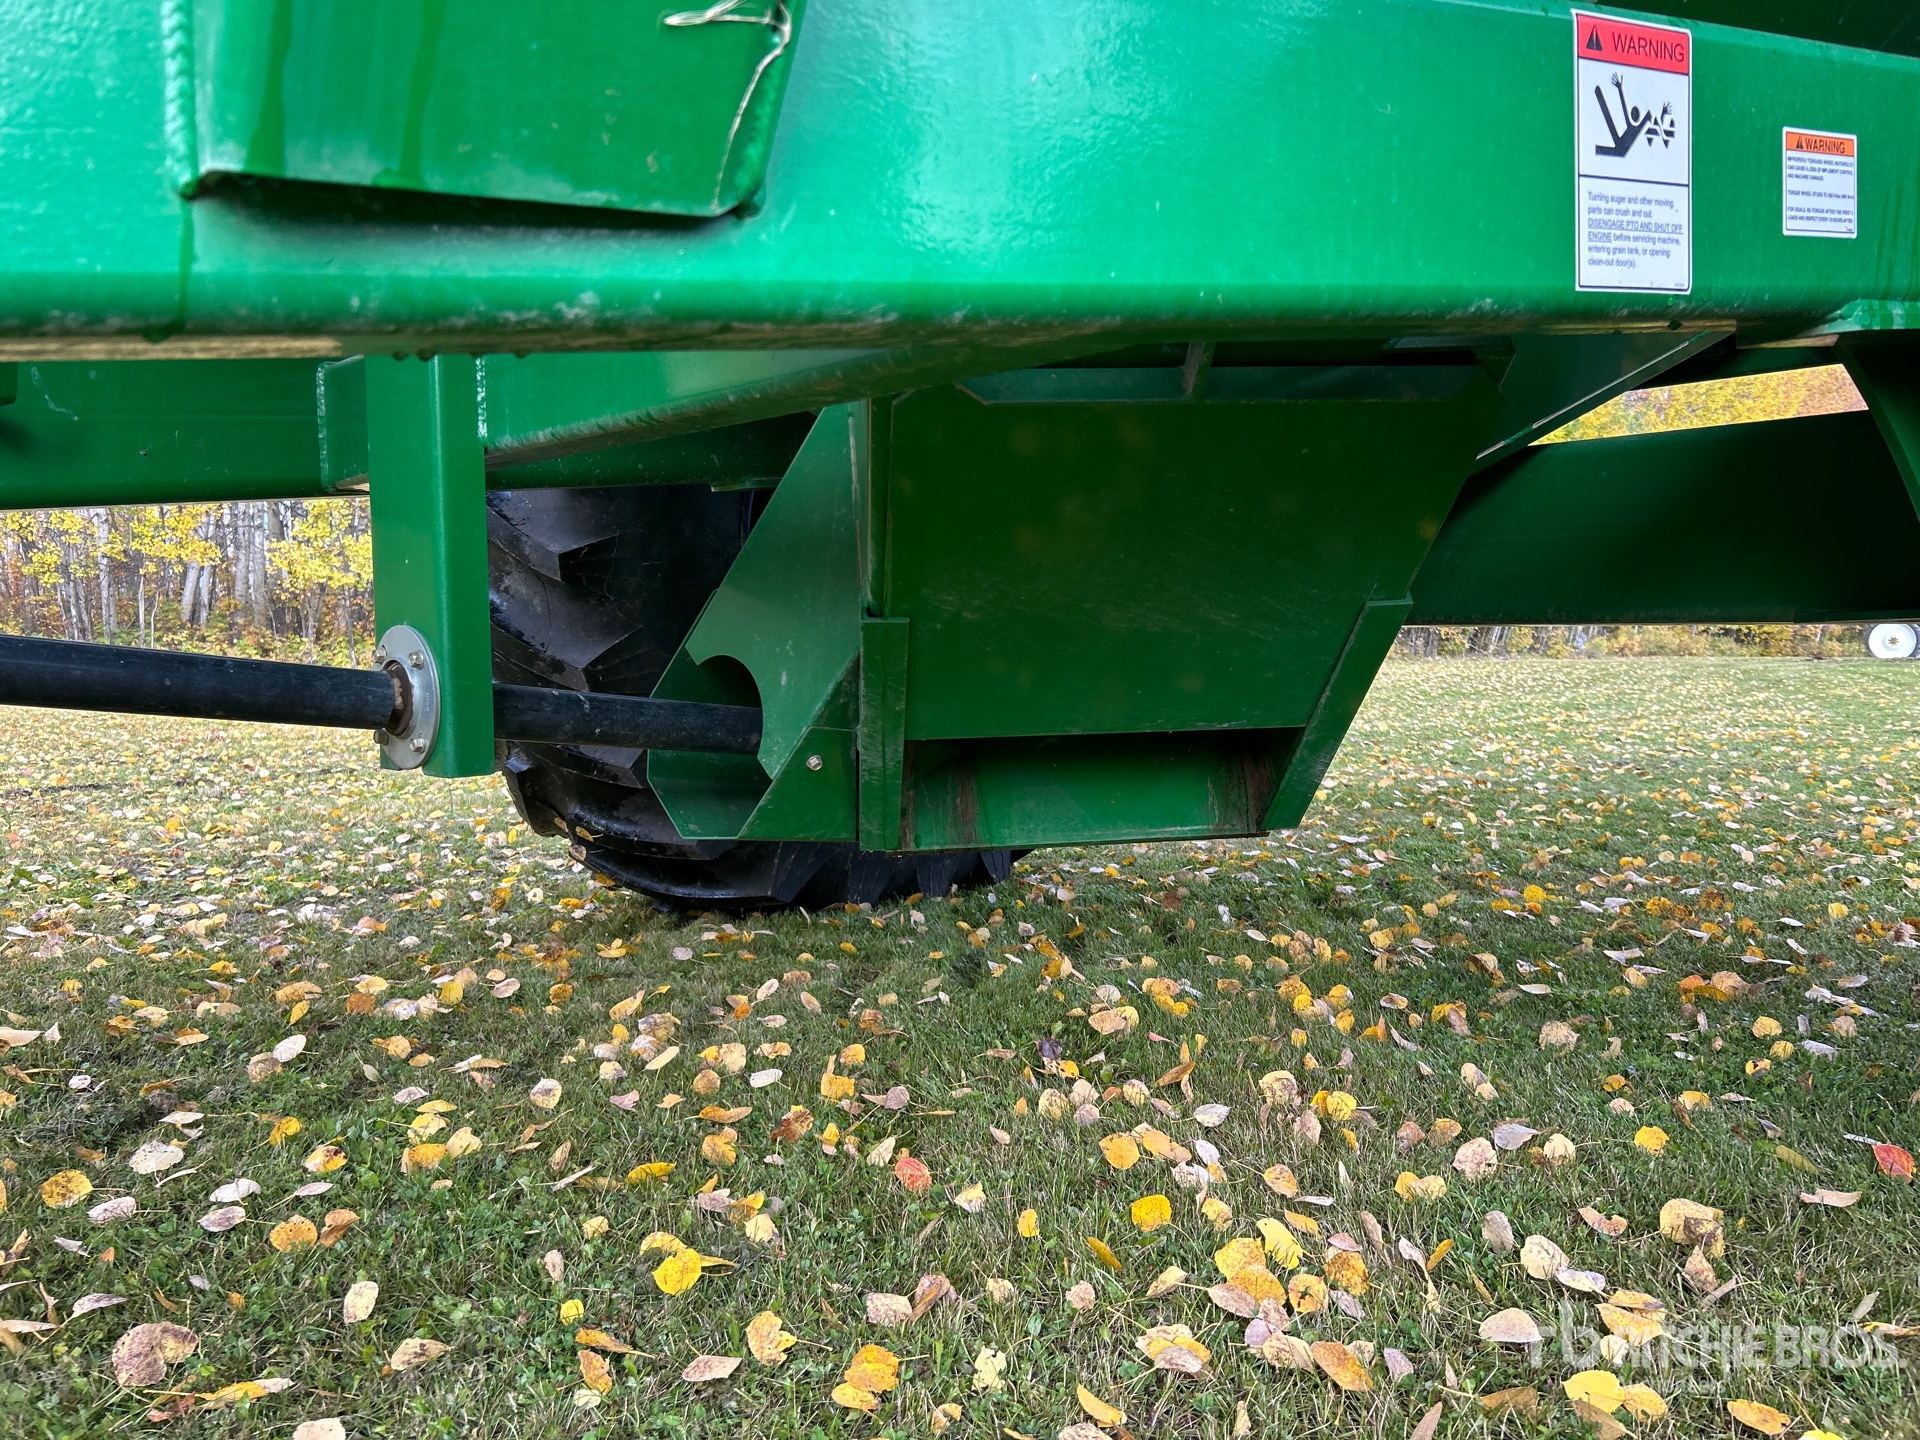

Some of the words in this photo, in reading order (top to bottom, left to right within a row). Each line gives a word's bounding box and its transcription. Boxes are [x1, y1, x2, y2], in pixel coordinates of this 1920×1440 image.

[1612, 32, 1684, 63] WARNING
[1805, 137, 1846, 154] WARNING
[1588, 191, 1609, 204] Turning
[1610, 195, 1627, 205] auger
[1628, 196, 1638, 204] and
[1640, 196, 1653, 205] other
[1654, 198, 1674, 210] moving
[1588, 206, 1602, 215] parts
[1615, 207, 1630, 216] crush
[1632, 209, 1642, 217] and
[1588, 218, 1625, 229] DISENGAGE
[1626, 220, 1639, 230] PTO
[1640, 221, 1653, 231] AND
[1654, 222, 1670, 232] SHUT
[1671, 223, 1683, 233] OFF
[1588, 231, 1612, 241] ENGINE
[1613, 233, 1631, 242] before
[1632, 235, 1656, 245] servicing
[1657, 236, 1681, 246] machine,
[1588, 245, 1611, 255] entering
[1612, 246, 1626, 256] grain
[1627, 247, 1641, 256] tank,
[1649, 249, 1671, 259] opening
[1588, 257, 1614, 267] clean-out
